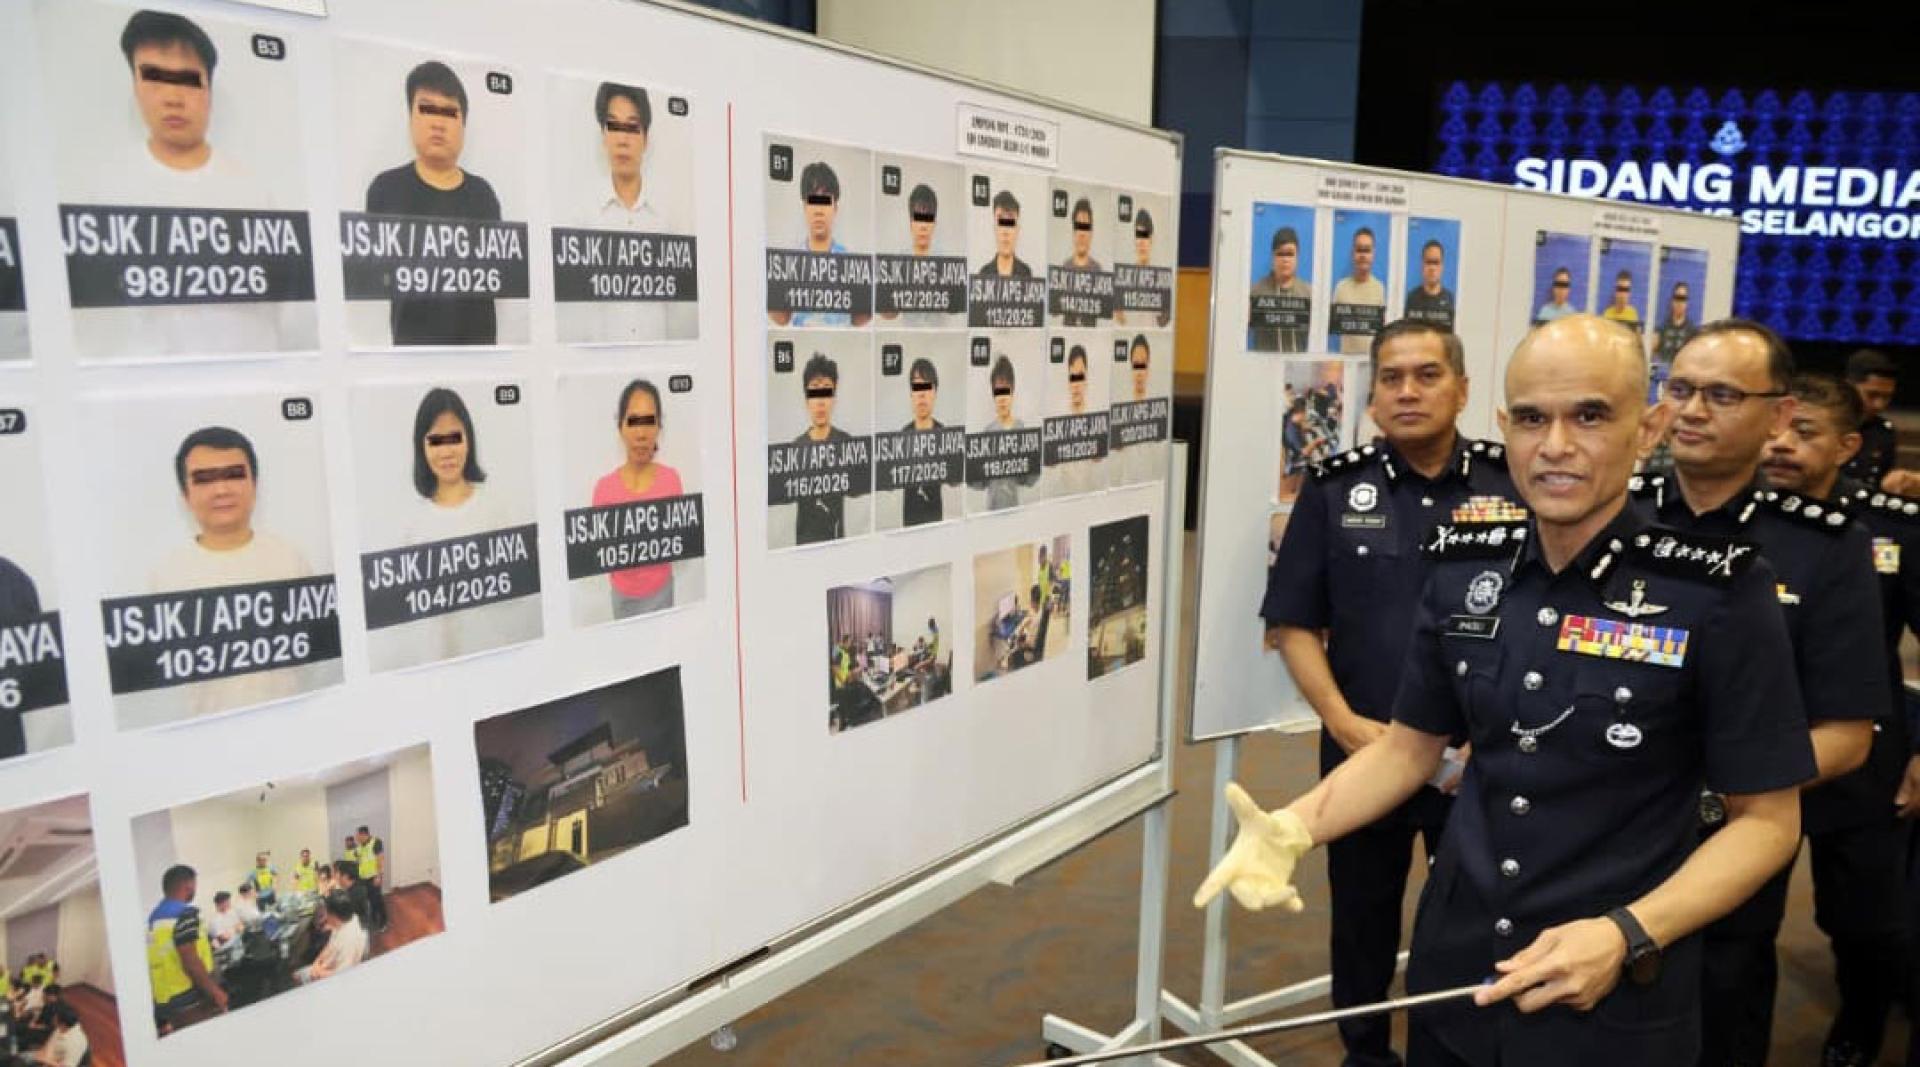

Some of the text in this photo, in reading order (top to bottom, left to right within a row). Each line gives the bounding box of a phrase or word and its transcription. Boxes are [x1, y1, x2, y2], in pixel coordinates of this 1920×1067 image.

[257, 41, 279, 56] B3
[490, 77, 508, 90] B4
[774, 154, 788, 176] B1
[1515, 158, 1733, 203] SIDANG
[64, 214, 142, 257] JSJK
[169, 216, 230, 255] APG
[238, 218, 301, 255] JAYA
[341, 221, 402, 257] JSJK
[423, 225, 469, 259] APG
[475, 228, 523, 260] JAYA
[557, 236, 604, 265] JSJK
[617, 240, 651, 267] APG
[657, 242, 692, 269] JAYA
[125, 265, 267, 298] 98/2026
[396, 267, 501, 293] 99/2026
[767, 254, 798, 280] JSJK
[809, 257, 837, 282] APG
[840, 259, 871, 284] JAYA
[913, 261, 936, 285] APG
[940, 262, 967, 286] JAYA
[590, 274, 676, 296] 100/2026
[788, 288, 852, 309] 111/2026
[287, 403, 307, 417] B8
[500, 389, 515, 401] B9
[768, 447, 800, 473] JSJK
[810, 443, 836, 470] APG
[839, 440, 868, 466] JAYA
[874, 437, 904, 461] JSJK
[913, 434, 935, 457] APG
[939, 431, 965, 455] JAYA
[784, 473, 849, 497] 116/2026
[891, 462, 947, 484] 117/2026
[567, 510, 608, 545] JSJK
[622, 505, 658, 535] APG
[662, 500, 699, 529] JAYA
[369, 551, 421, 591] JSJK
[438, 541, 479, 575] APG
[484, 533, 528, 567] JAYA
[596, 536, 683, 568] 105/2026
[405, 572, 511, 614] 104/2026
[106, 602, 186, 648] JSJK
[212, 592, 273, 634] APG
[282, 582, 338, 624] JAYA
[156, 632, 310, 679] 103/2026
